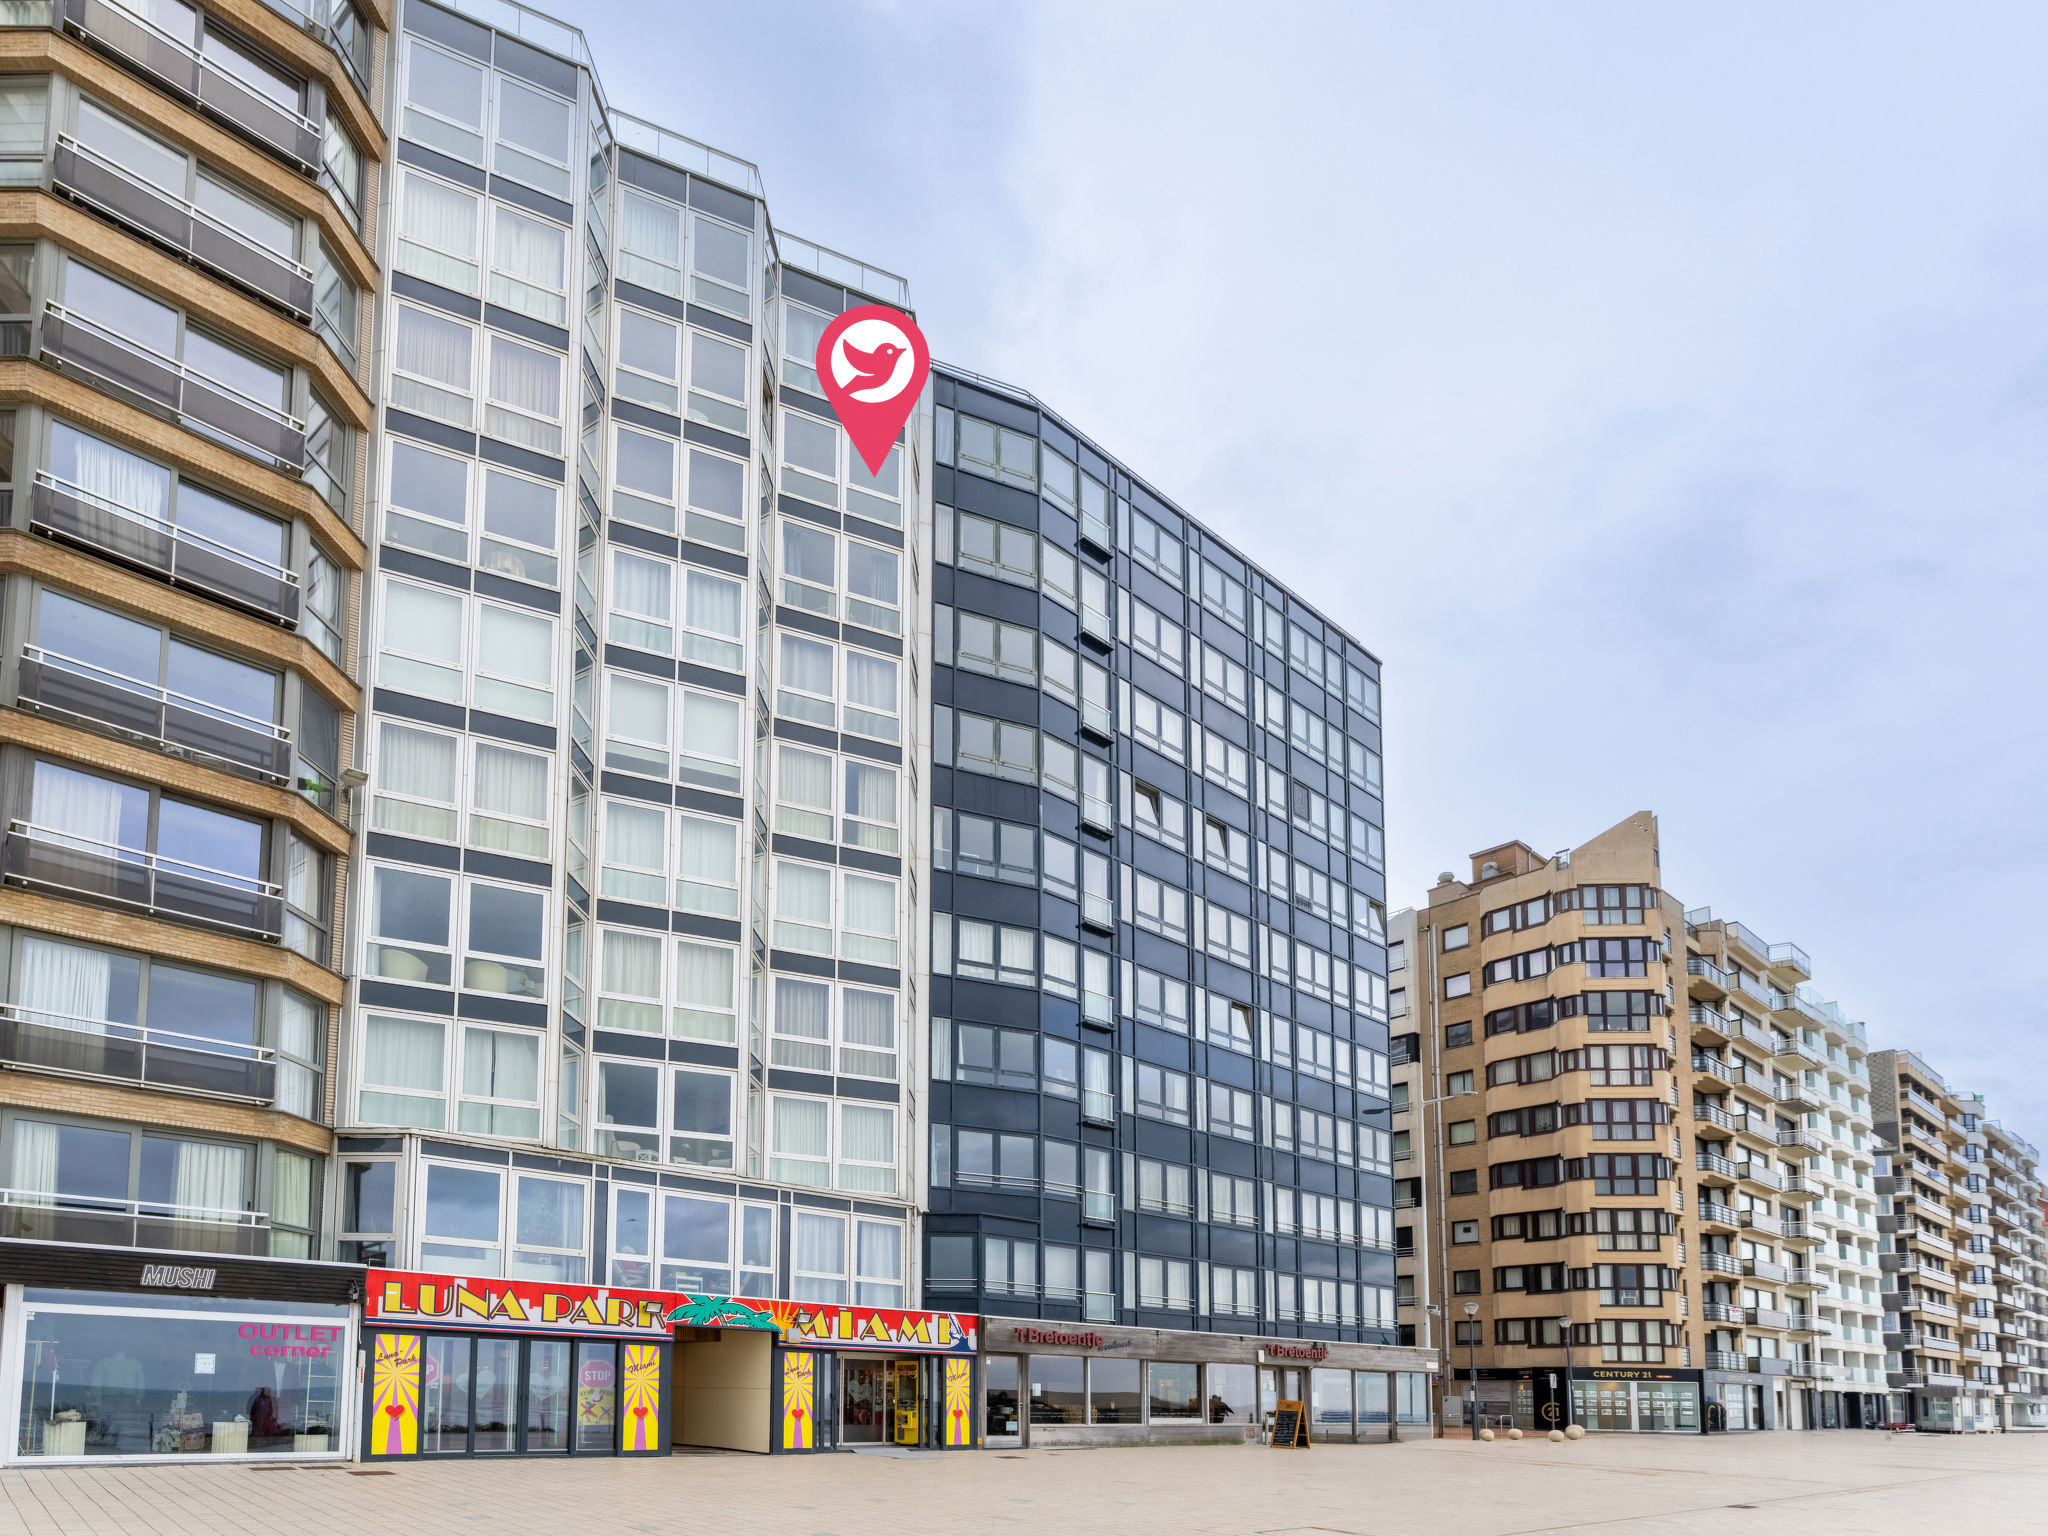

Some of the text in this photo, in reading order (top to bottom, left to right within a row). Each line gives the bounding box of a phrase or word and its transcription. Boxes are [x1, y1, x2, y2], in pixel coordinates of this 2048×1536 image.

[141, 1264, 217, 1290] MUSHI
[383, 1281, 666, 1329] LUNA PARK
[238, 1323, 343, 1342] OUTLET
[795, 1306, 952, 1345] MIAMI
[1027, 1328, 1105, 1350] Bretoentje
[250, 1344, 331, 1358] corner
[1277, 1344, 1330, 1362] Bretoentje
[394, 1354, 417, 1368] Park
[628, 1360, 657, 1374] Miami
[584, 1370, 611, 1382] STOP
[1593, 1370, 1640, 1378] CENTURY
[1642, 1371, 1652, 1379] 21
